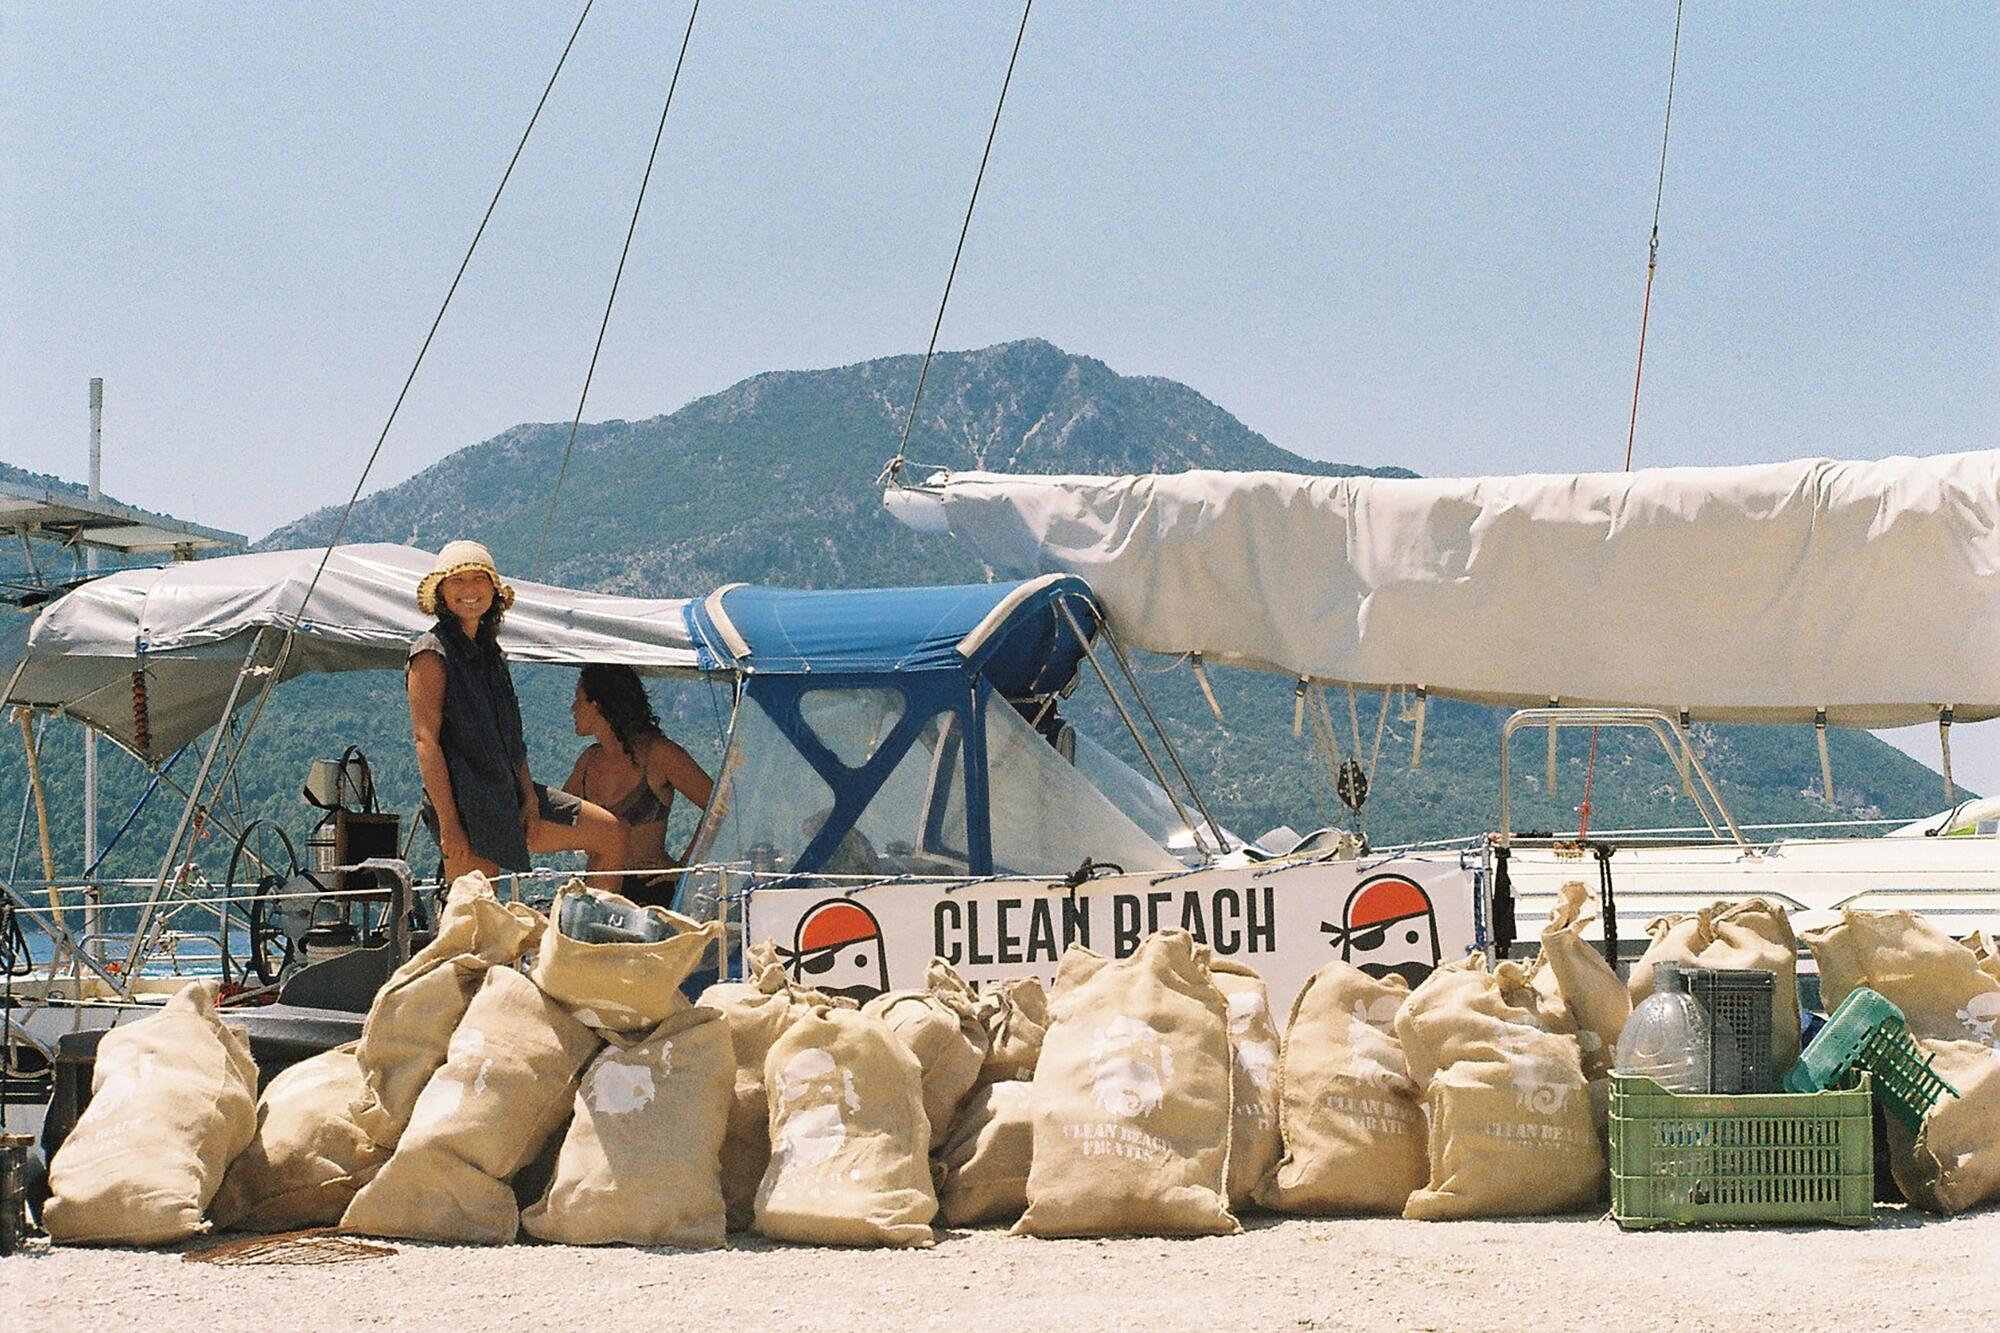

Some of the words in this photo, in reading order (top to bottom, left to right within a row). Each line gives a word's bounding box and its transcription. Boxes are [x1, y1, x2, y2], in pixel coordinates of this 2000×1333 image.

[934, 895, 1091, 966] CLEAN
[1113, 886, 1276, 960] BEACH
[1062, 1122, 1118, 1138] CLEAN
